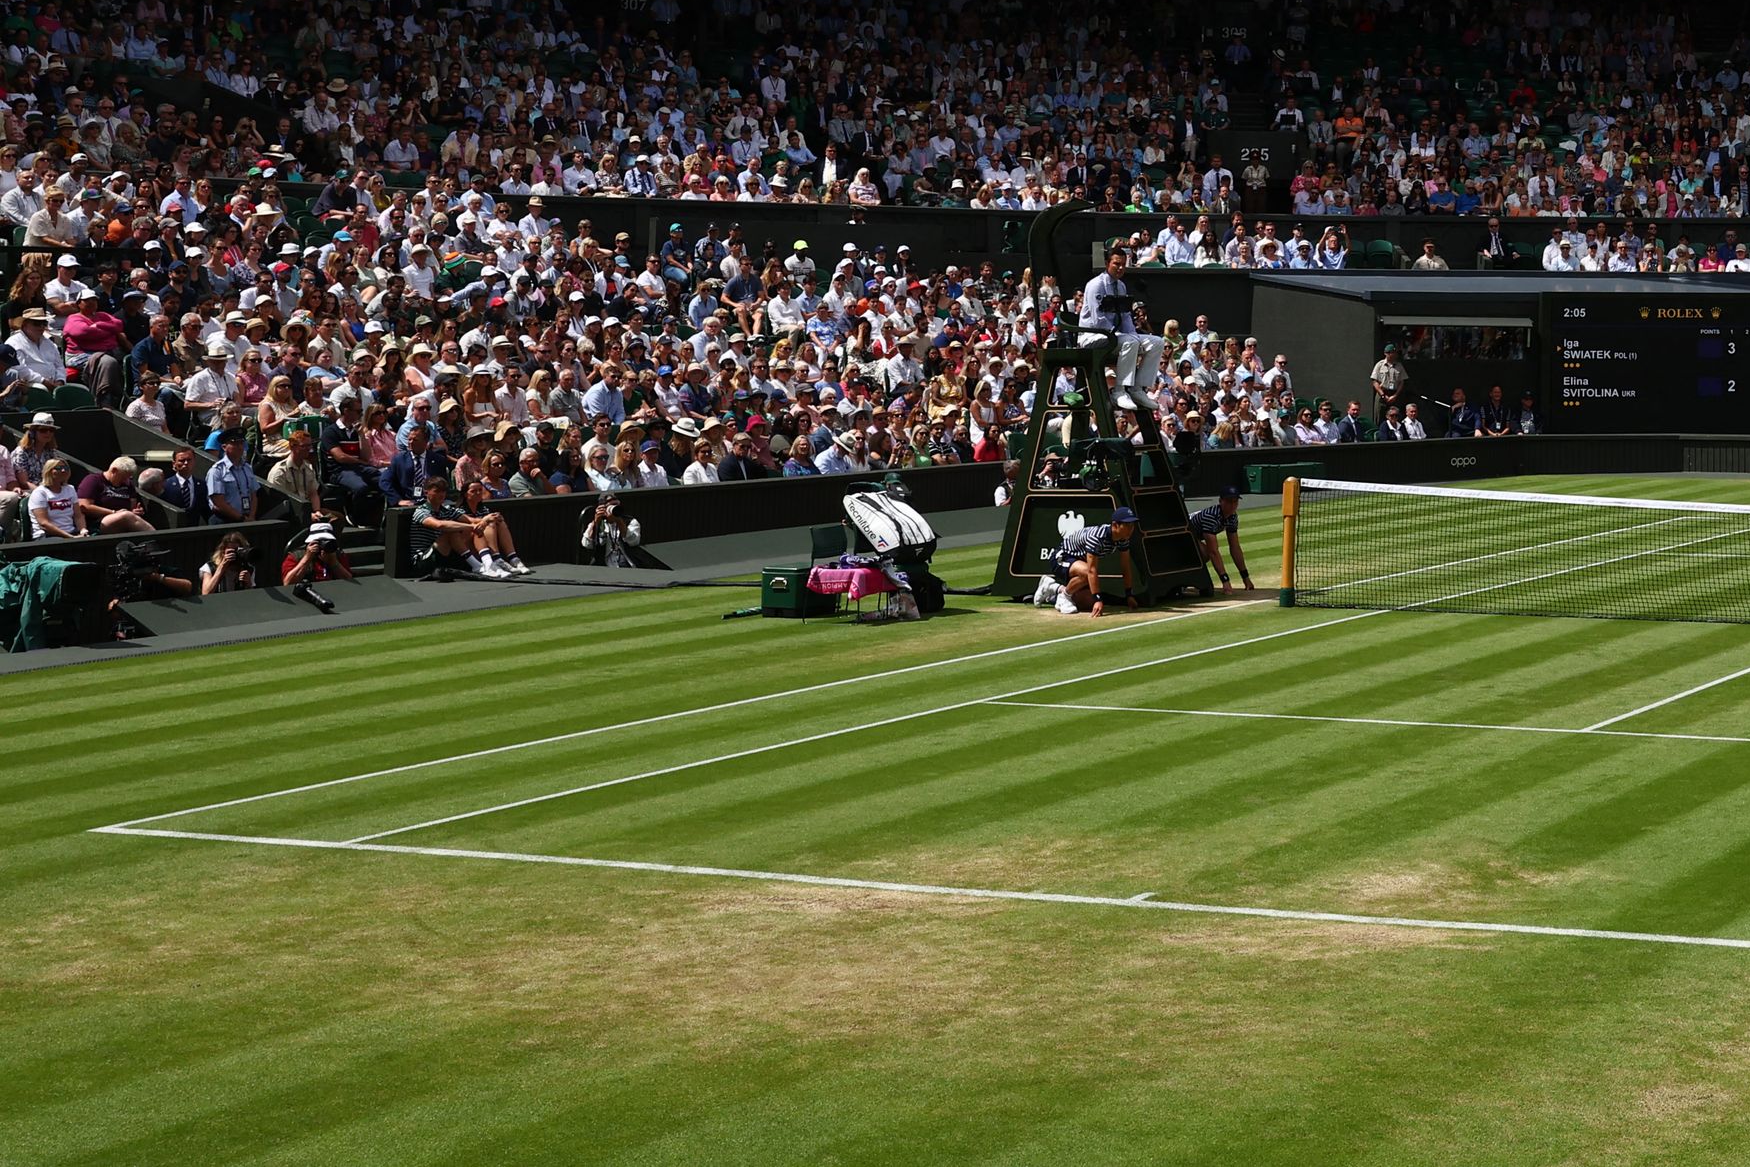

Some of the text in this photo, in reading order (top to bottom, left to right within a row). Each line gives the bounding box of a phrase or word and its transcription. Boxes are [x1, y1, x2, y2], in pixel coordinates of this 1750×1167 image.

[1240, 147, 1269, 161] 25
[1563, 308, 1586, 317] 2:05
[1657, 308, 1704, 319] ROLEX
[1563, 338, 1579, 349] Iga
[1727, 342, 1736, 354] 3
[1563, 350, 1611, 359] SWIATEK
[1629, 353, 1638, 361] (1)
[1563, 376, 1589, 386] Elina
[1727, 380, 1736, 392] 2
[1563, 388, 1619, 398] SVITOLINA
[1450, 457, 1477, 468] oppo
[847, 500, 877, 540] Tecnifibre
